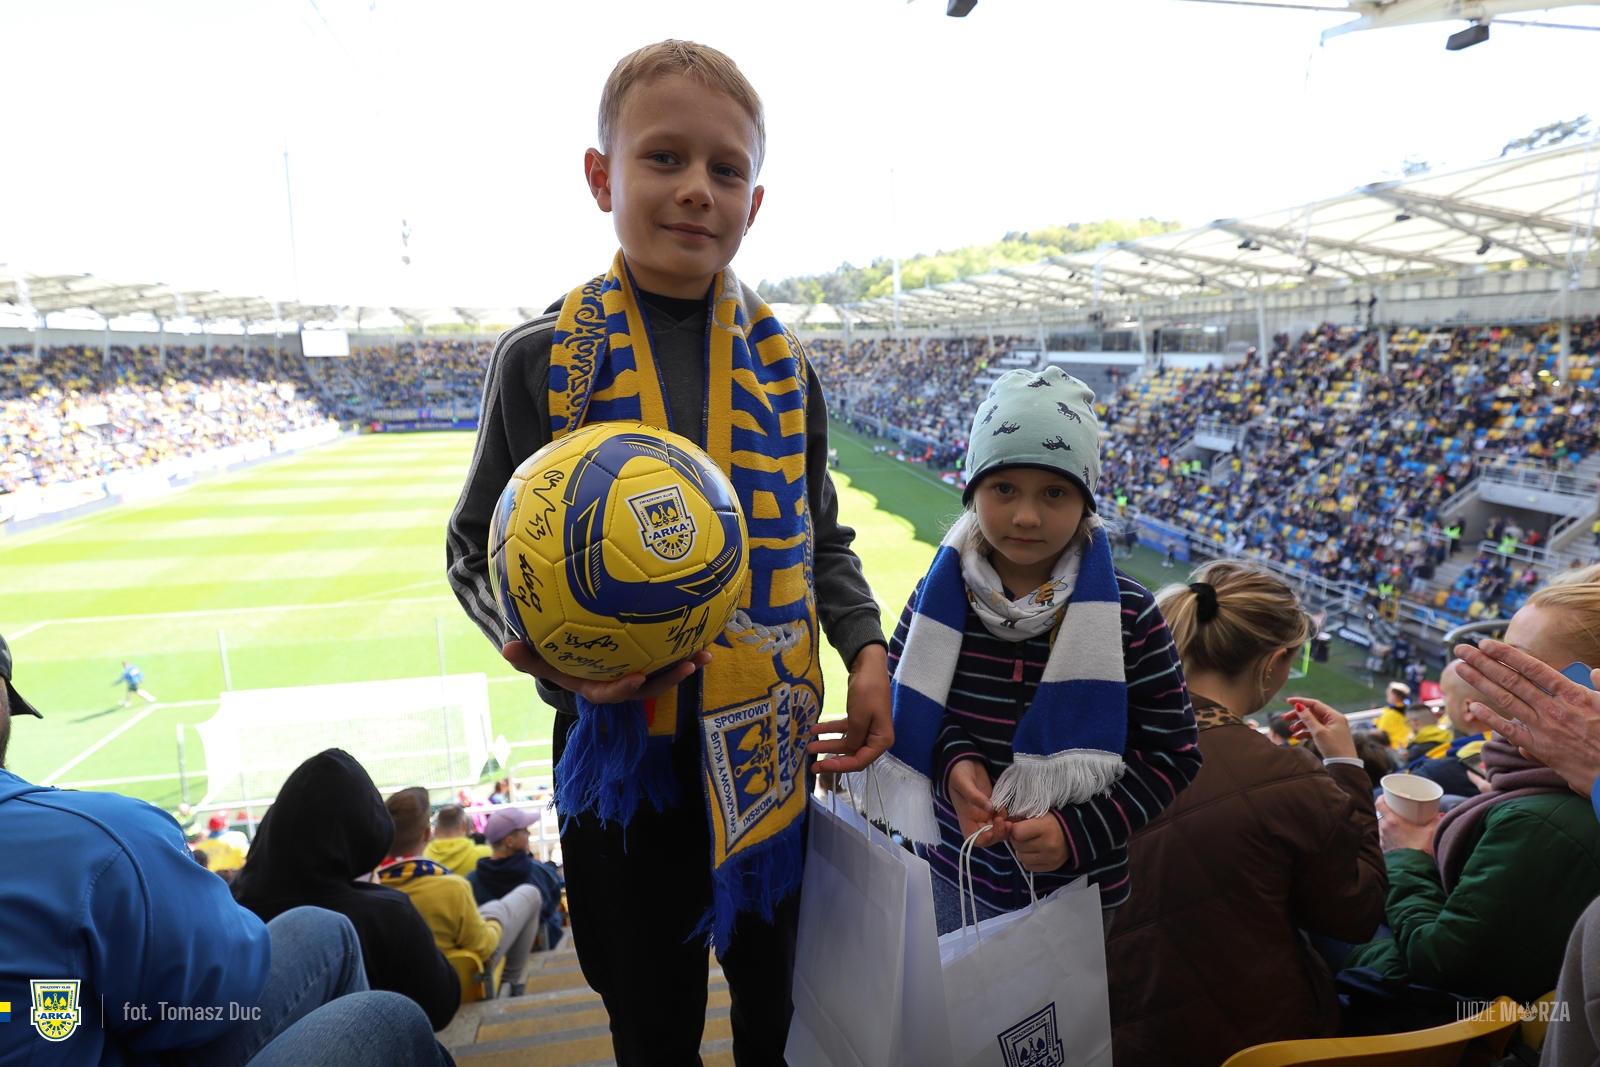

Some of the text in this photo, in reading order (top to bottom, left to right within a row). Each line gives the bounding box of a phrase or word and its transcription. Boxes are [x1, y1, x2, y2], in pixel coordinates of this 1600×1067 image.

[652, 522, 688, 541] ARKA
[714, 701, 770, 729] SPORTOWY
[710, 731, 724, 764] KLUB
[776, 693, 791, 783] ARKA
[742, 795, 773, 827] MORSKI
